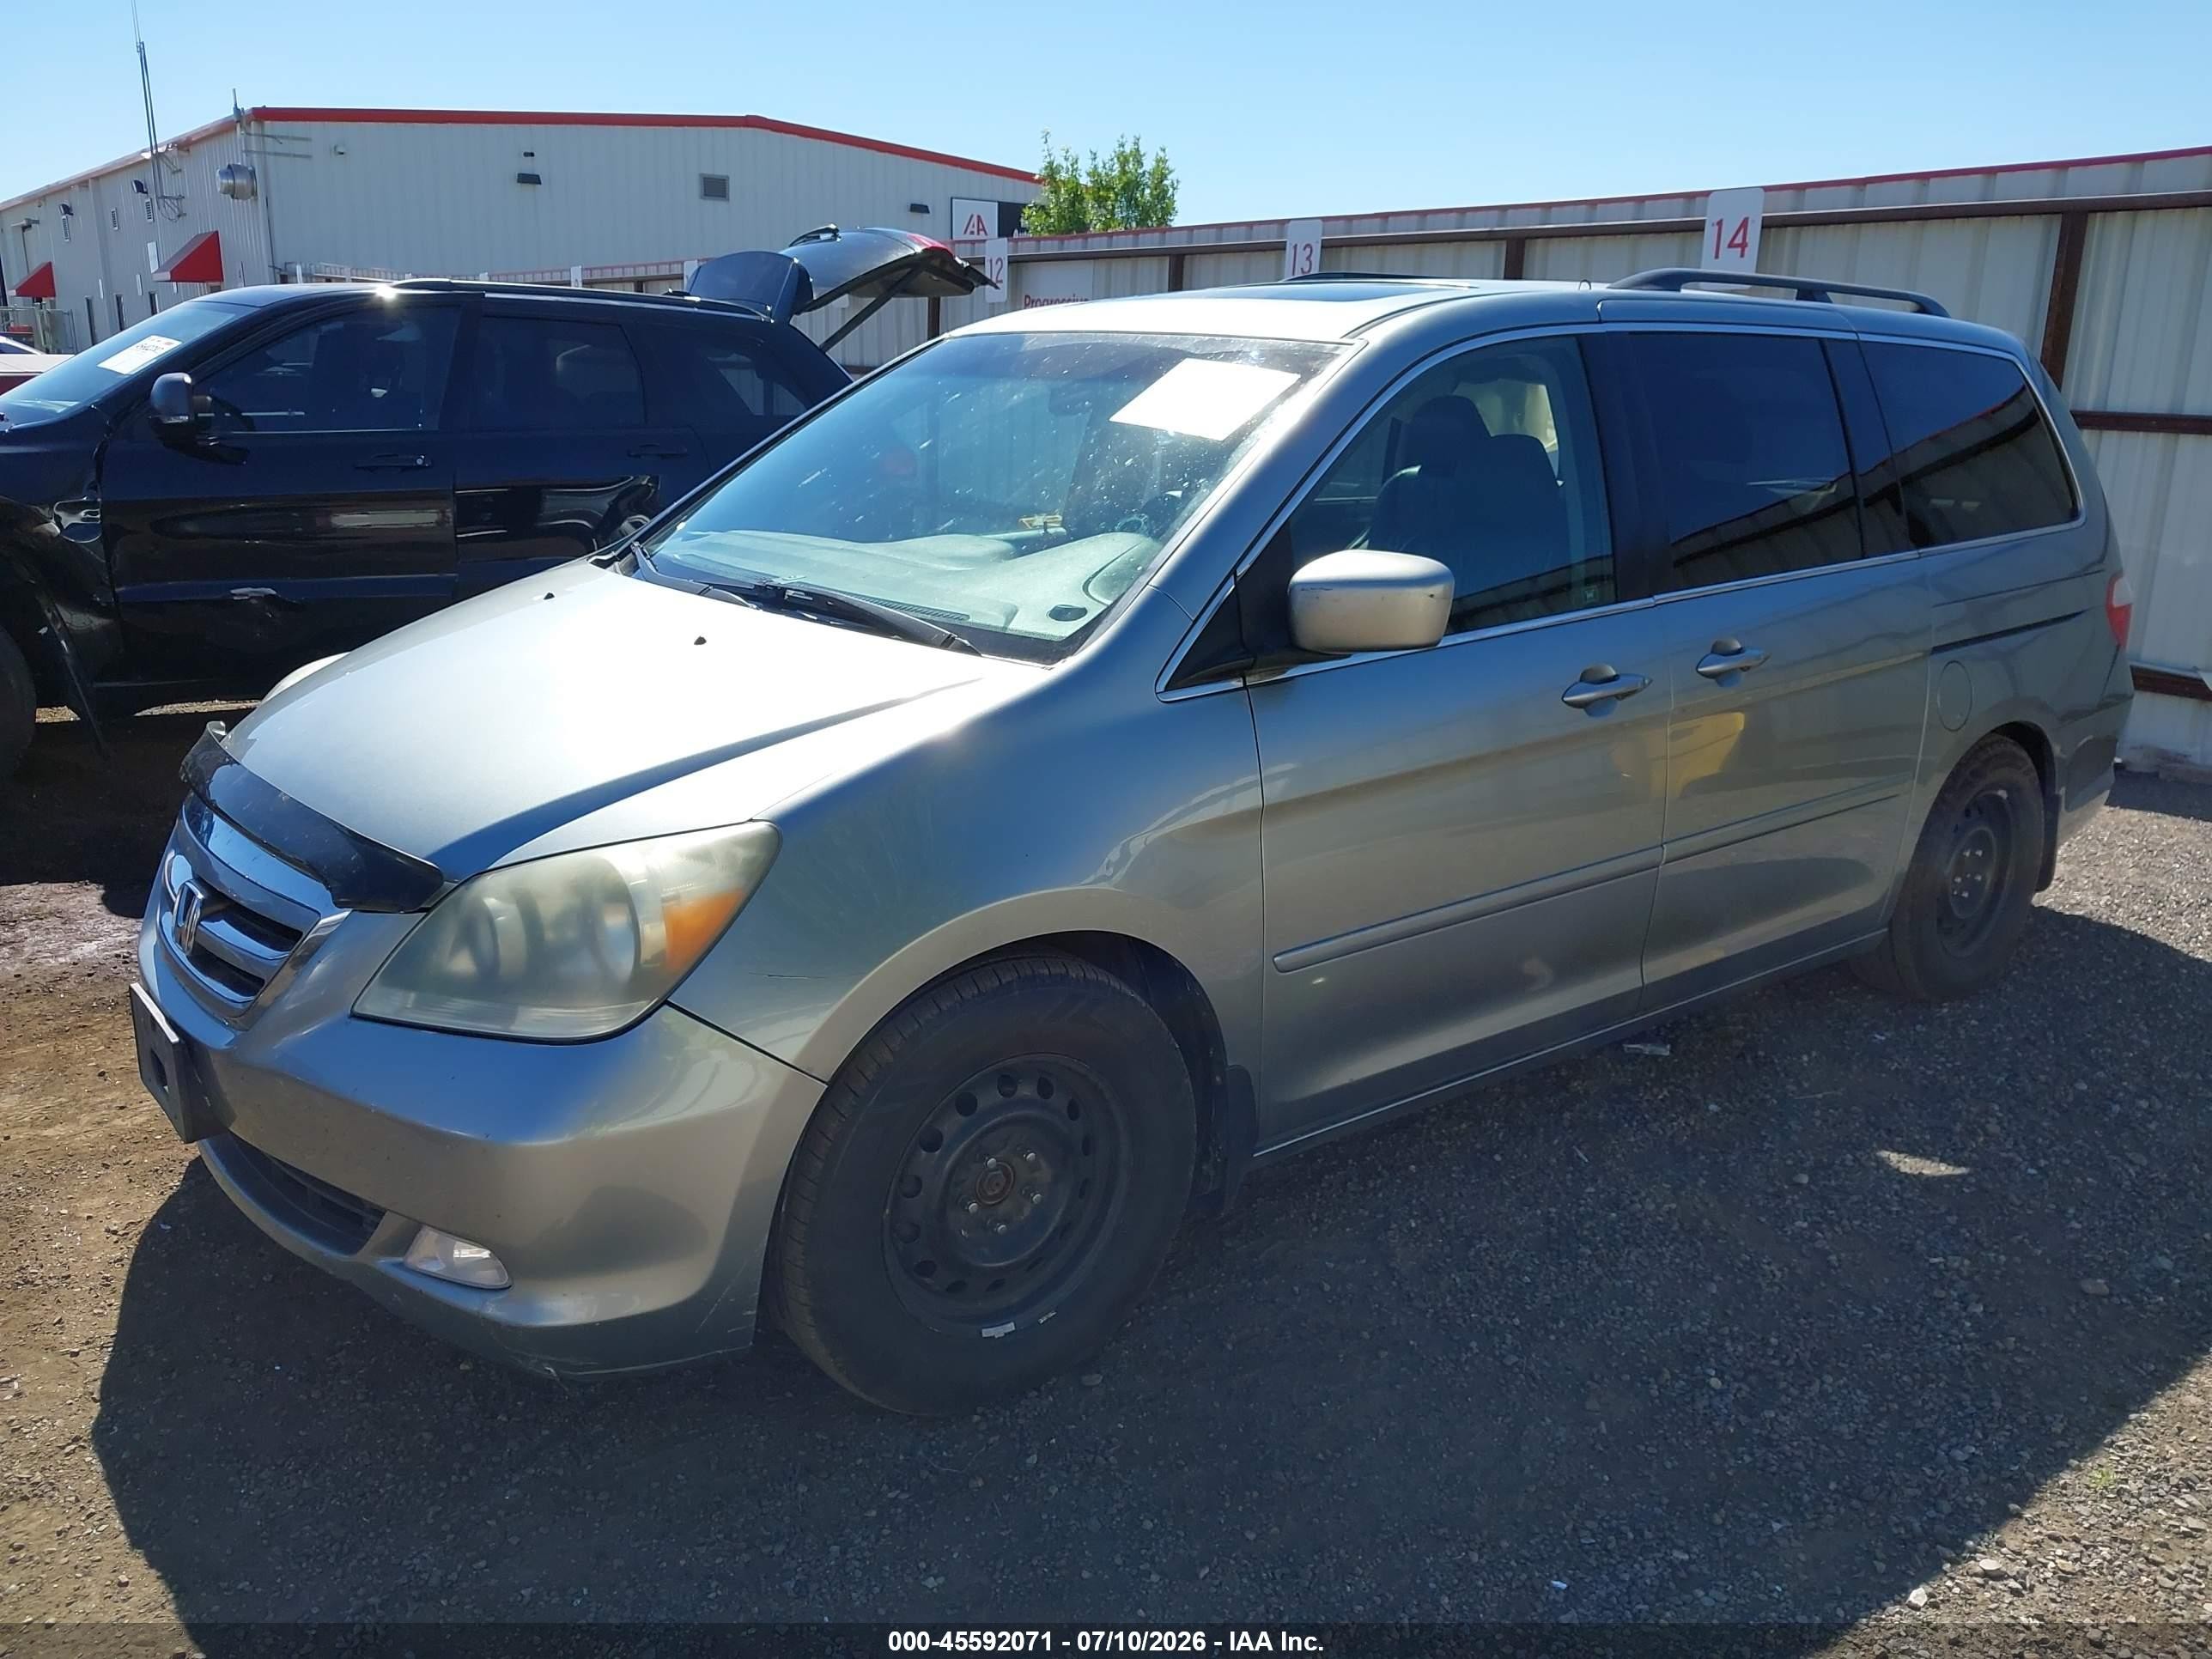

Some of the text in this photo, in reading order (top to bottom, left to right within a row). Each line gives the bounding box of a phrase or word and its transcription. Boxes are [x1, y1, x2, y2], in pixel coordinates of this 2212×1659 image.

[1714, 216, 1750, 259] 14
[989, 257, 1004, 284] 12
[1291, 242, 1314, 276] 13
